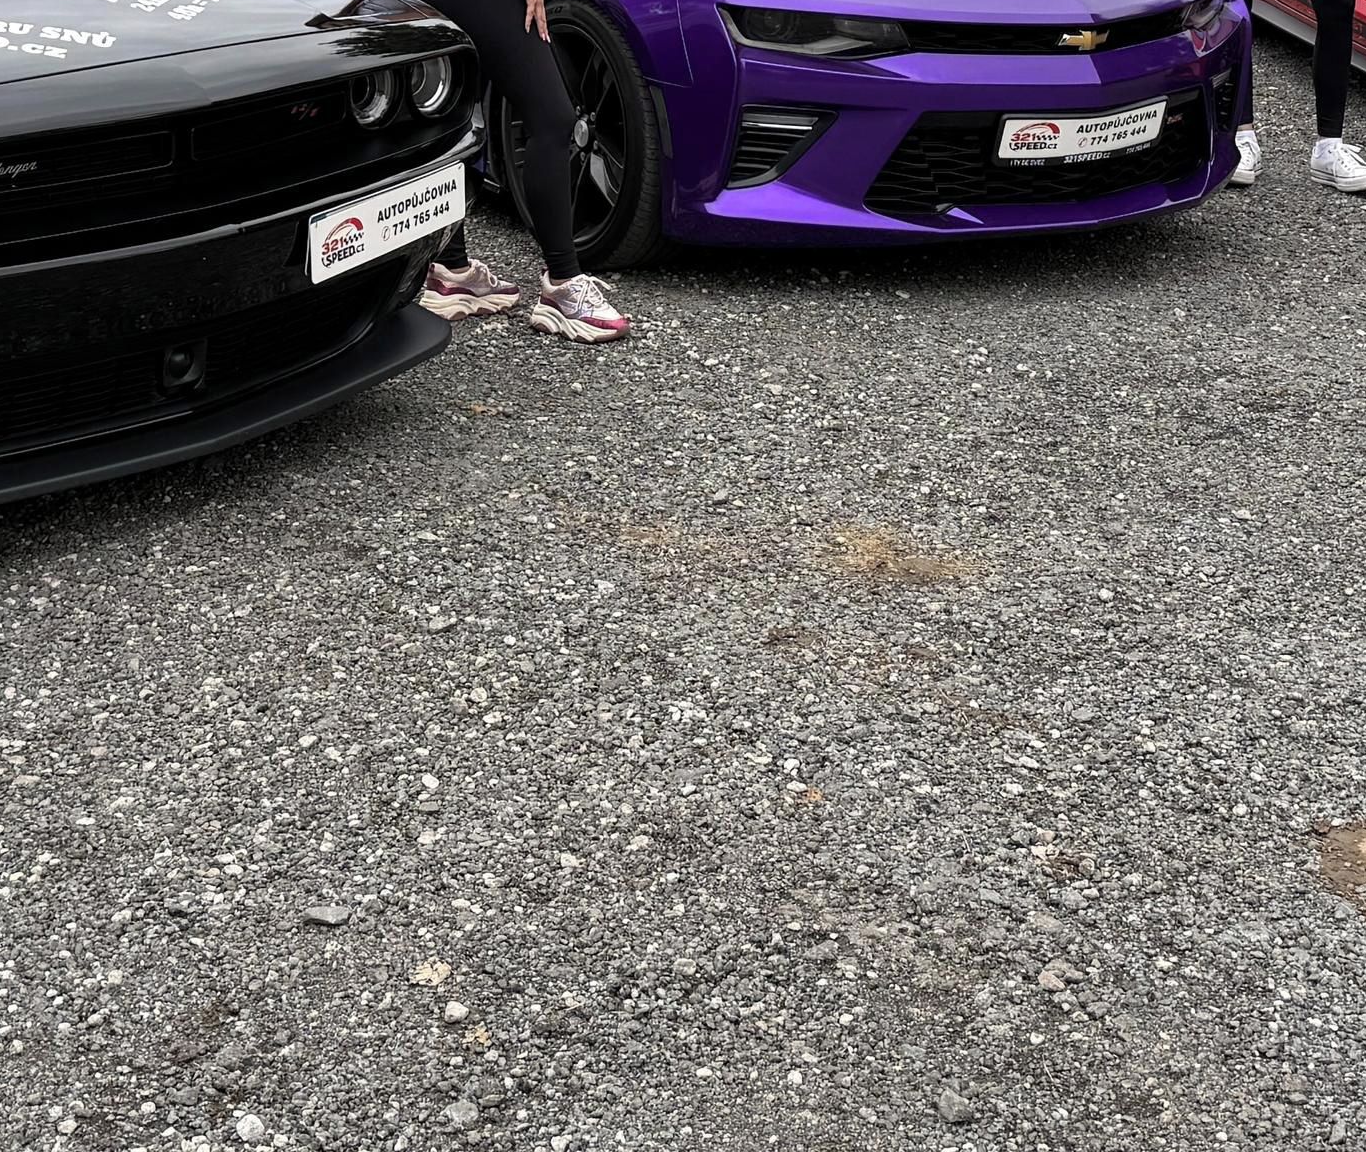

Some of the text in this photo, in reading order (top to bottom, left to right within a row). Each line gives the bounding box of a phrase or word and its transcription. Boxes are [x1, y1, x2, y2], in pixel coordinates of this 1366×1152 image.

[1076, 109, 1158, 134] AUTOPŮJČOVNA
[1090, 125, 1147, 146] 774 765 444
[377, 178, 457, 223] AUTOPŮJČOVNA
[392, 201, 450, 236] 774 765 444
